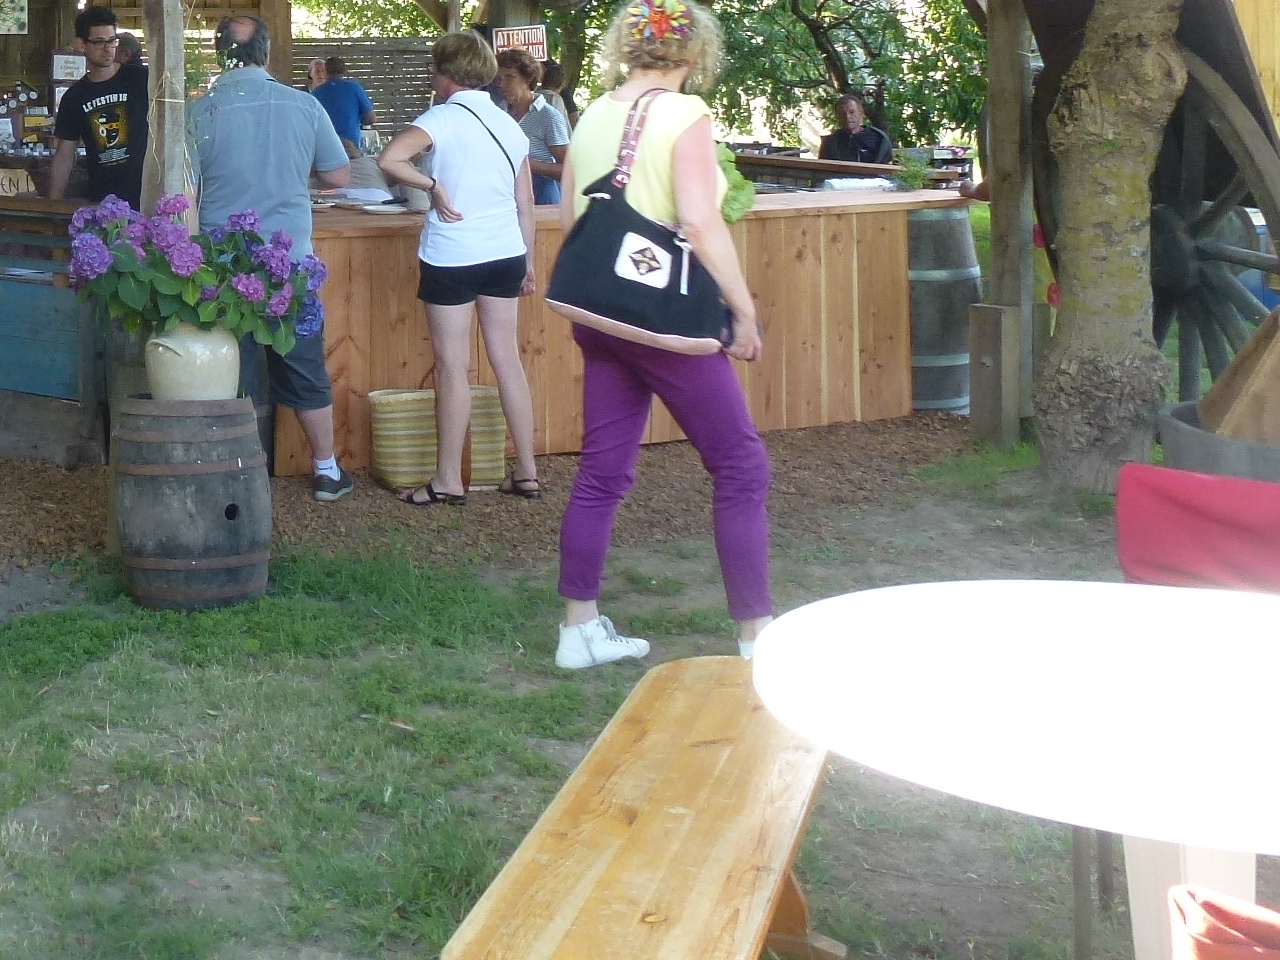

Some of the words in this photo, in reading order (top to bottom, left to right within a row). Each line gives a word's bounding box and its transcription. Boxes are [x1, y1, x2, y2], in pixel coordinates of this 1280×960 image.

[497, 27, 544, 46] ATTENTION
[82, 101, 93, 113] LE
[92, 93, 118, 108] FESTIN
